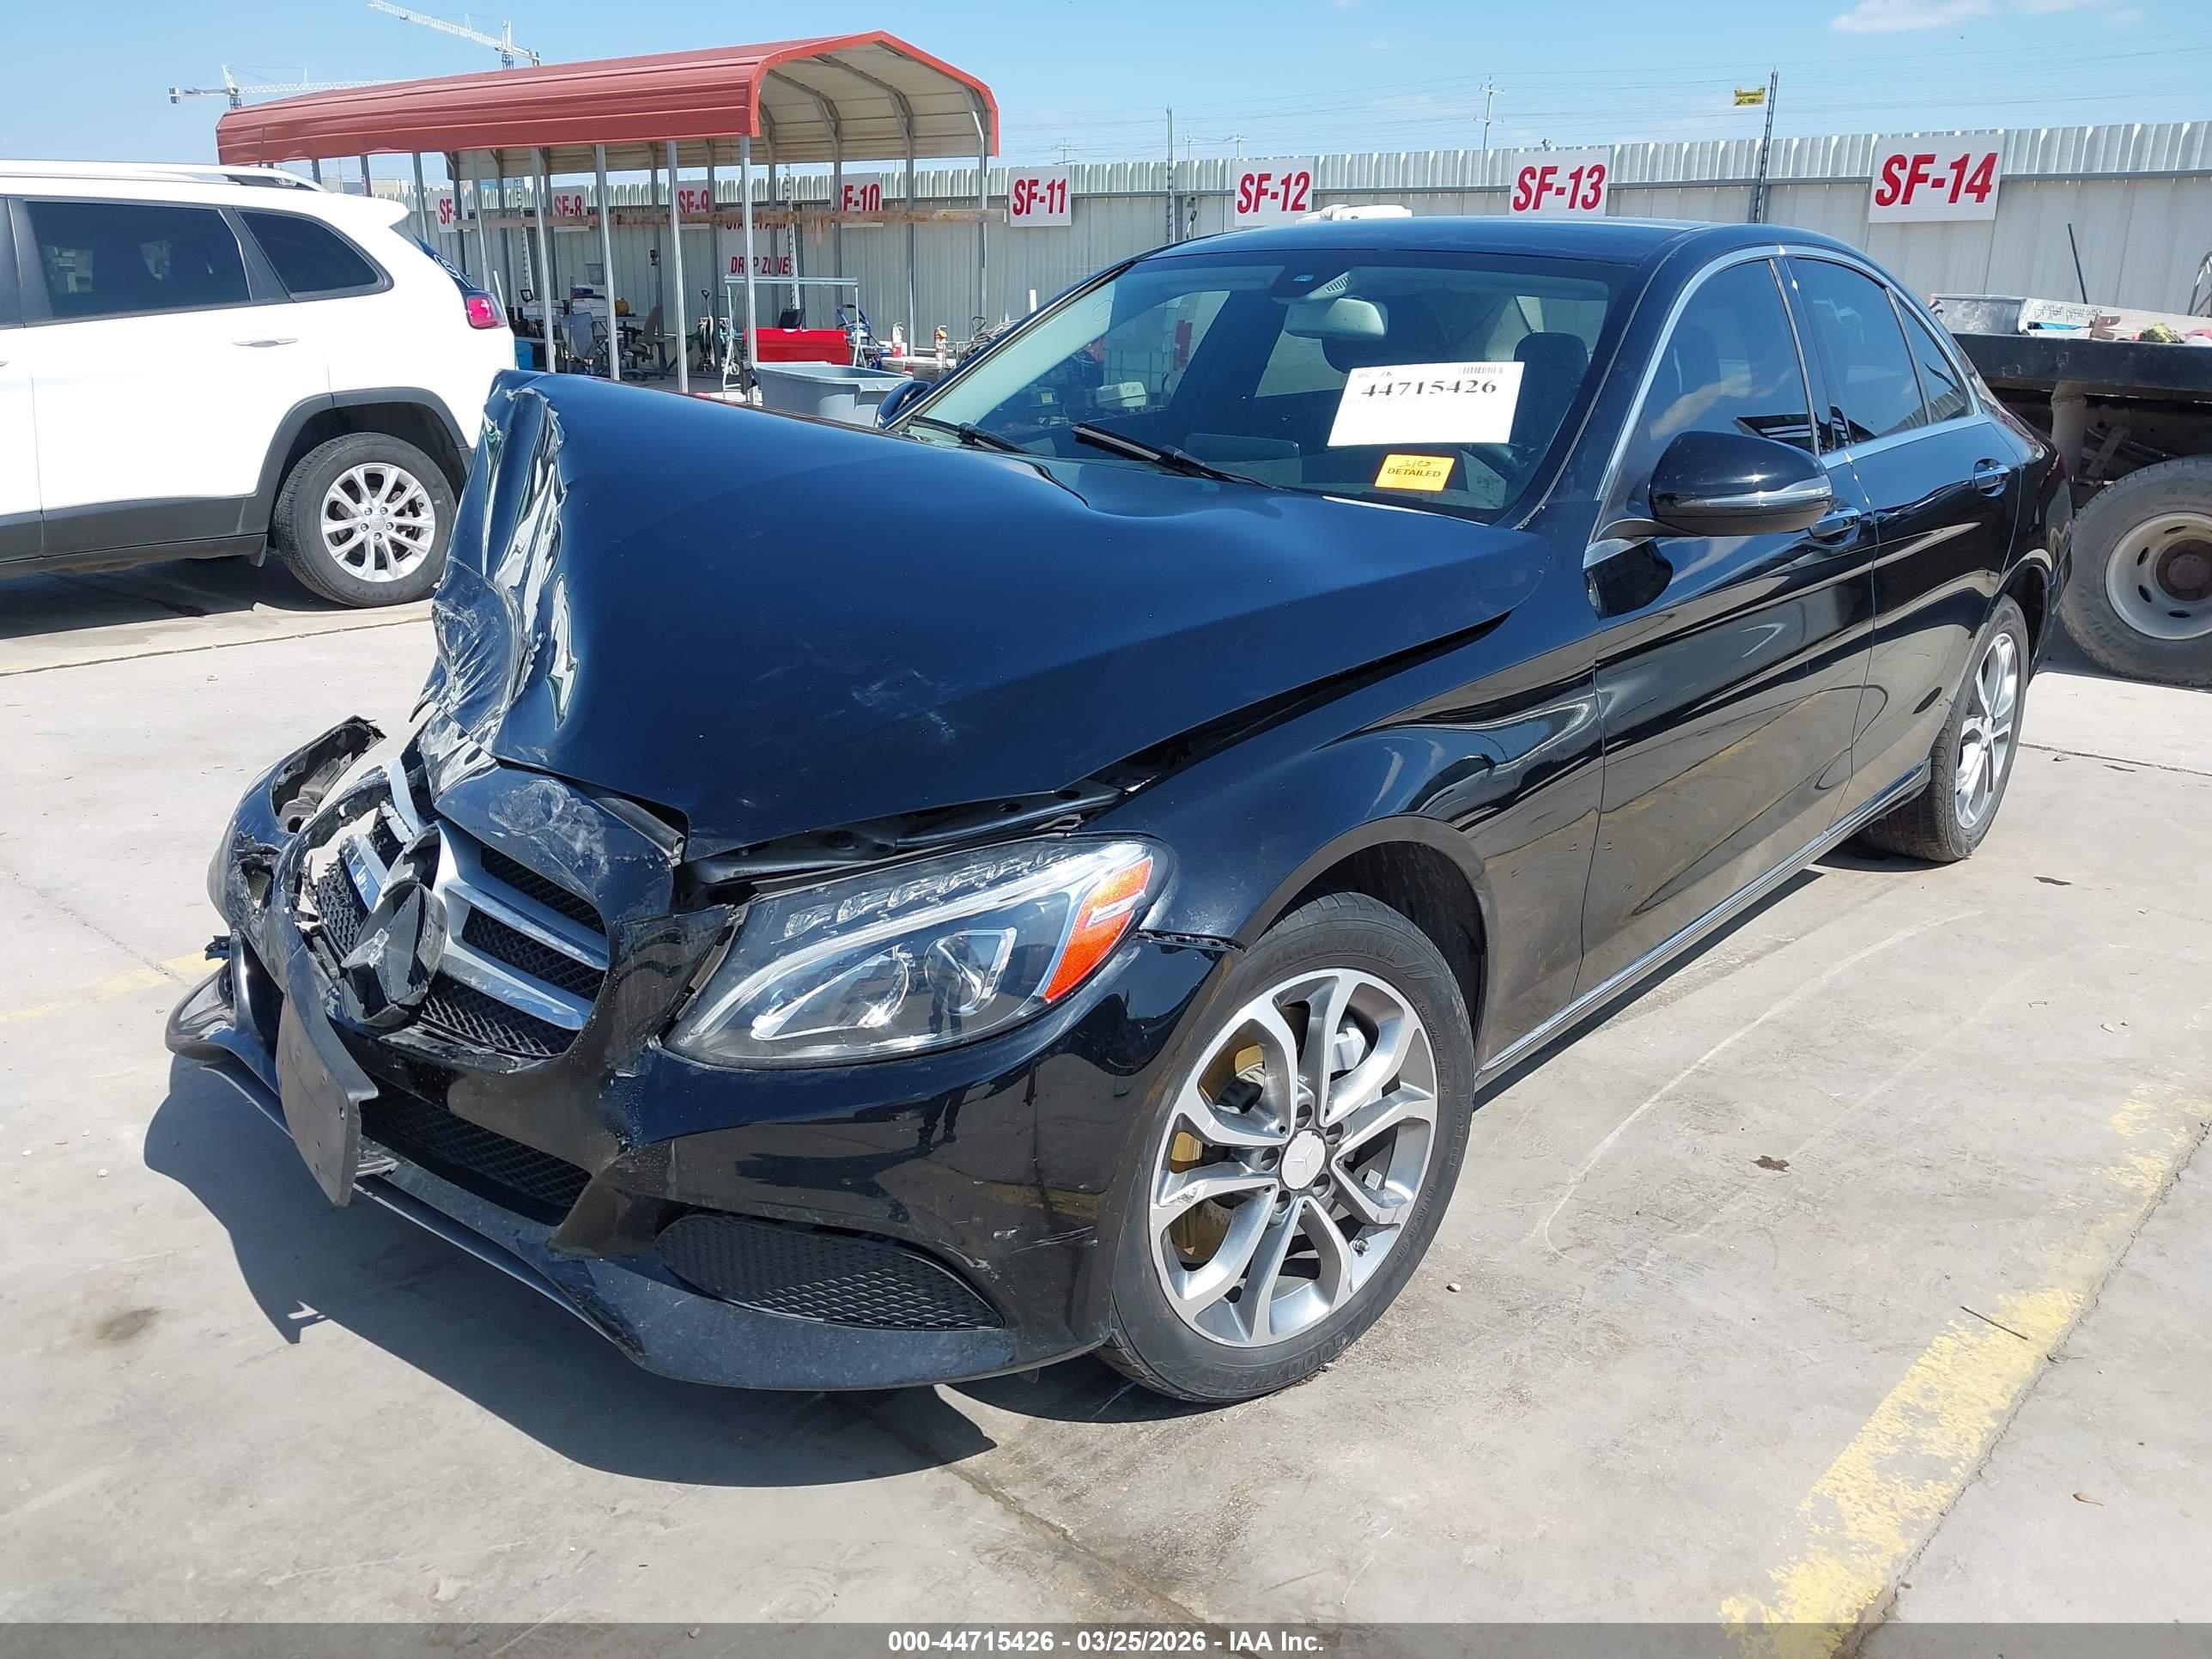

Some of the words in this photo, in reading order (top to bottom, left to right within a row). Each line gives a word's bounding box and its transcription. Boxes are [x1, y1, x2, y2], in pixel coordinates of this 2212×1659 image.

[1237, 172, 1310, 214] SF-12
[1512, 164, 1607, 211] SF-13
[1875, 153, 1998, 207] SF-14
[554, 195, 583, 216] SF-8
[678, 190, 709, 214] SF-9
[840, 183, 880, 211] F-10
[1012, 179, 1066, 216] SF-11
[439, 198, 458, 225] SF-
[731, 257, 759, 274] DRP
[1361, 380, 1498, 397] 44715426
[1387, 468, 1442, 477] DETAILED
